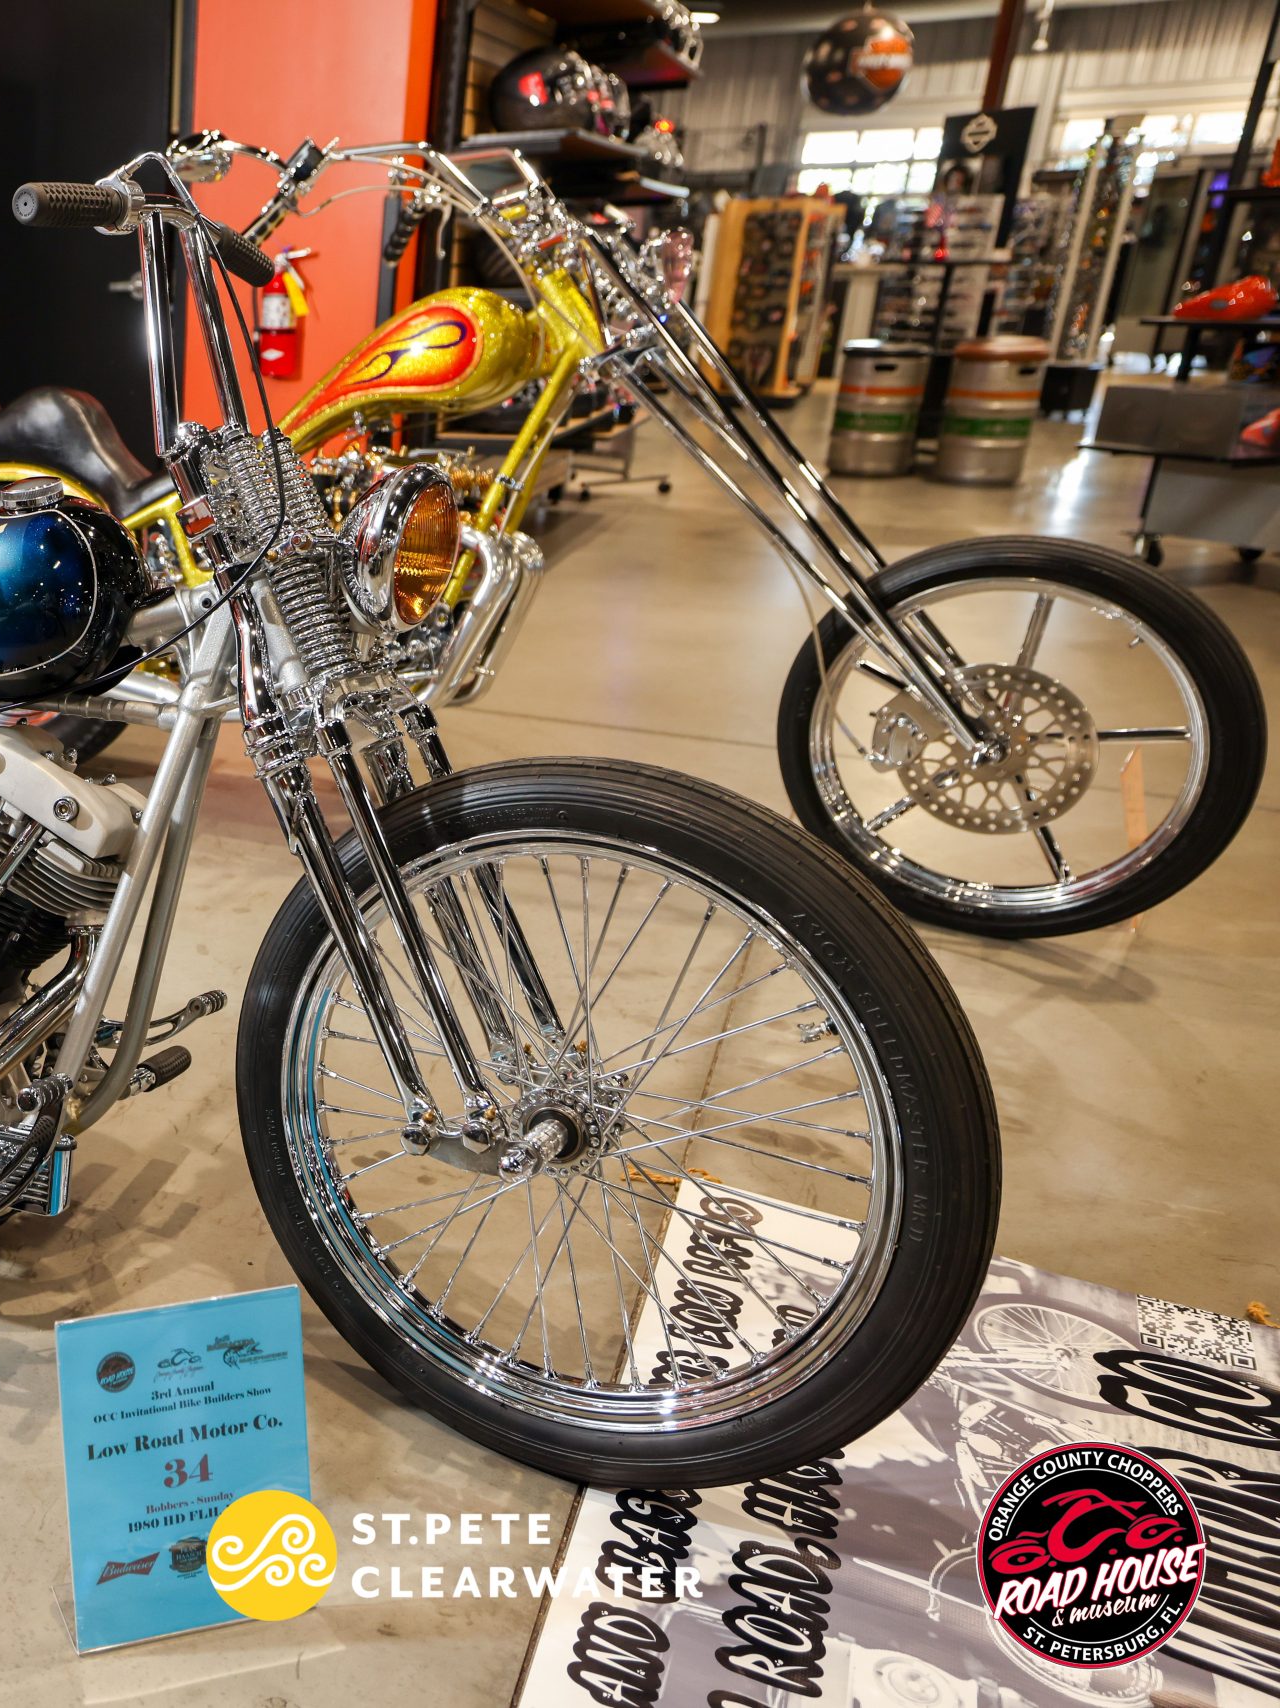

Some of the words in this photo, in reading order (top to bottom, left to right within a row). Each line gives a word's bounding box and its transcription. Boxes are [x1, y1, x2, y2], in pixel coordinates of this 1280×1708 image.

[151, 1386, 172, 1401] 3rd
[176, 1381, 215, 1397] Annual
[93, 1412, 118, 1424] OCC
[120, 1402, 177, 1420] Invitational
[179, 1397, 202, 1410] Bike
[204, 1391, 245, 1405] Builders
[247, 1386, 272, 1398] Show
[87, 1442, 129, 1461] Low
[134, 1429, 185, 1452] Road
[190, 1420, 248, 1442] Motor
[253, 1413, 283, 1430] Co.
[163, 1453, 214, 1489] 34
[146, 1501, 189, 1515] Bobbers
[197, 1492, 234, 1504] Sunday
[128, 1520, 160, 1534] 1980
[163, 1514, 186, 1527] HD
[103, 1560, 156, 1578] Budweiser
